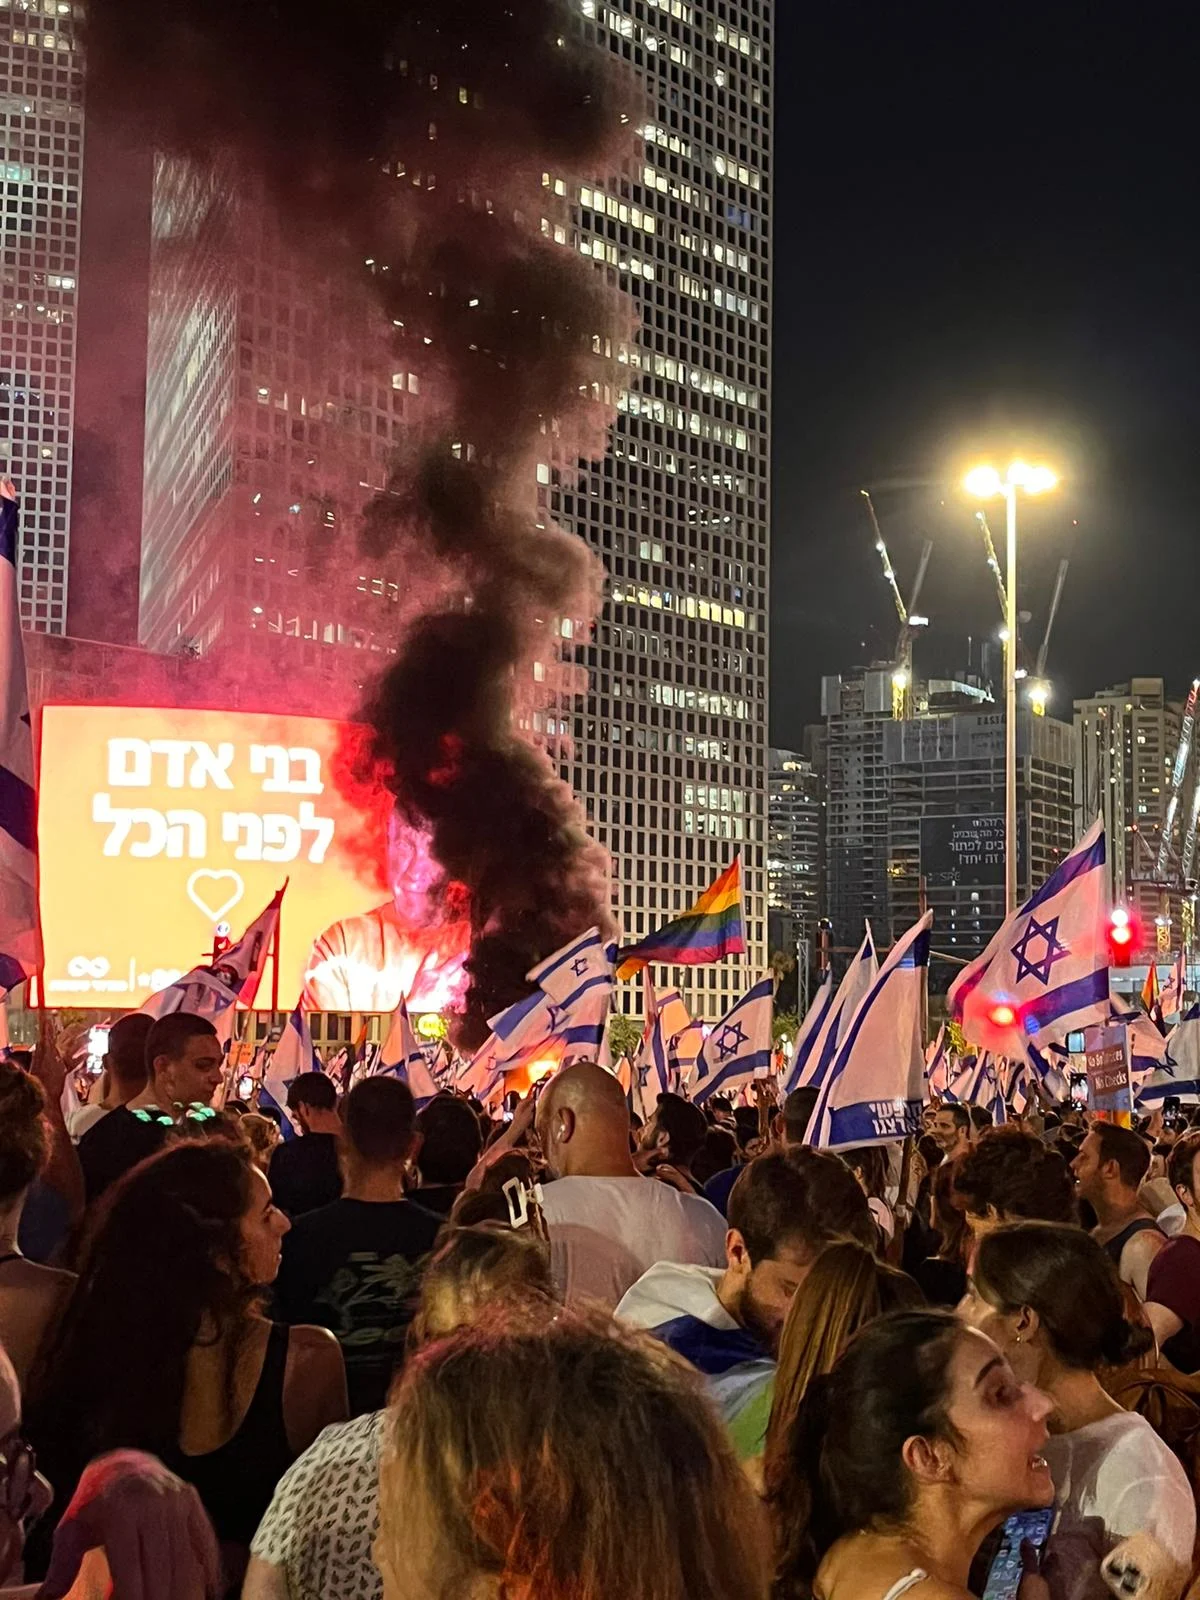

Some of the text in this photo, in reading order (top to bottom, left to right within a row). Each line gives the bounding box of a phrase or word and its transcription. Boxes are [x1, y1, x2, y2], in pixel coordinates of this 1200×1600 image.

[107, 737, 325, 795] בני אדם
[92, 792, 335, 864] לפני הכל
[948, 839, 982, 852] לפתור
[985, 853, 999, 864] זה
